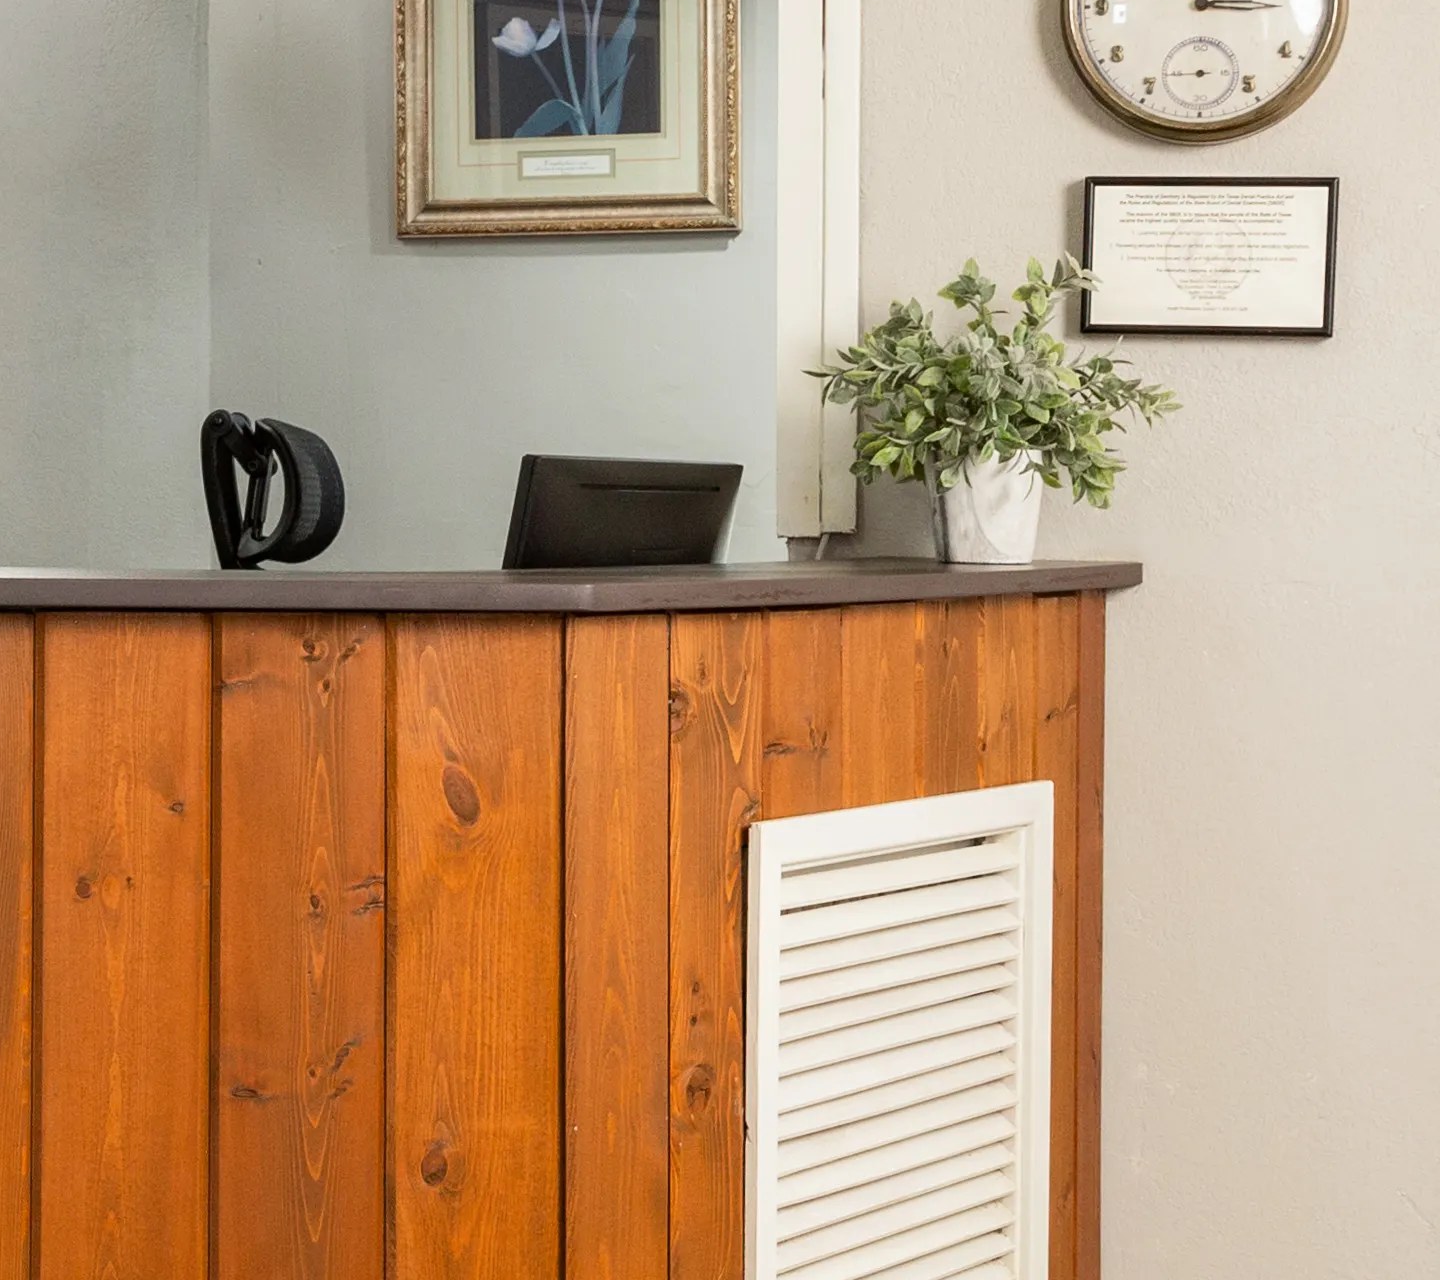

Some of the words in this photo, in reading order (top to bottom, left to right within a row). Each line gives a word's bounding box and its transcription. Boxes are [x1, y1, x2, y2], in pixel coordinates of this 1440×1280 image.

[1109, 45, 1124, 63] 8
[1277, 40, 1292, 59] 4
[1143, 76, 1158, 95] 7
[1241, 74, 1256, 94] 5
